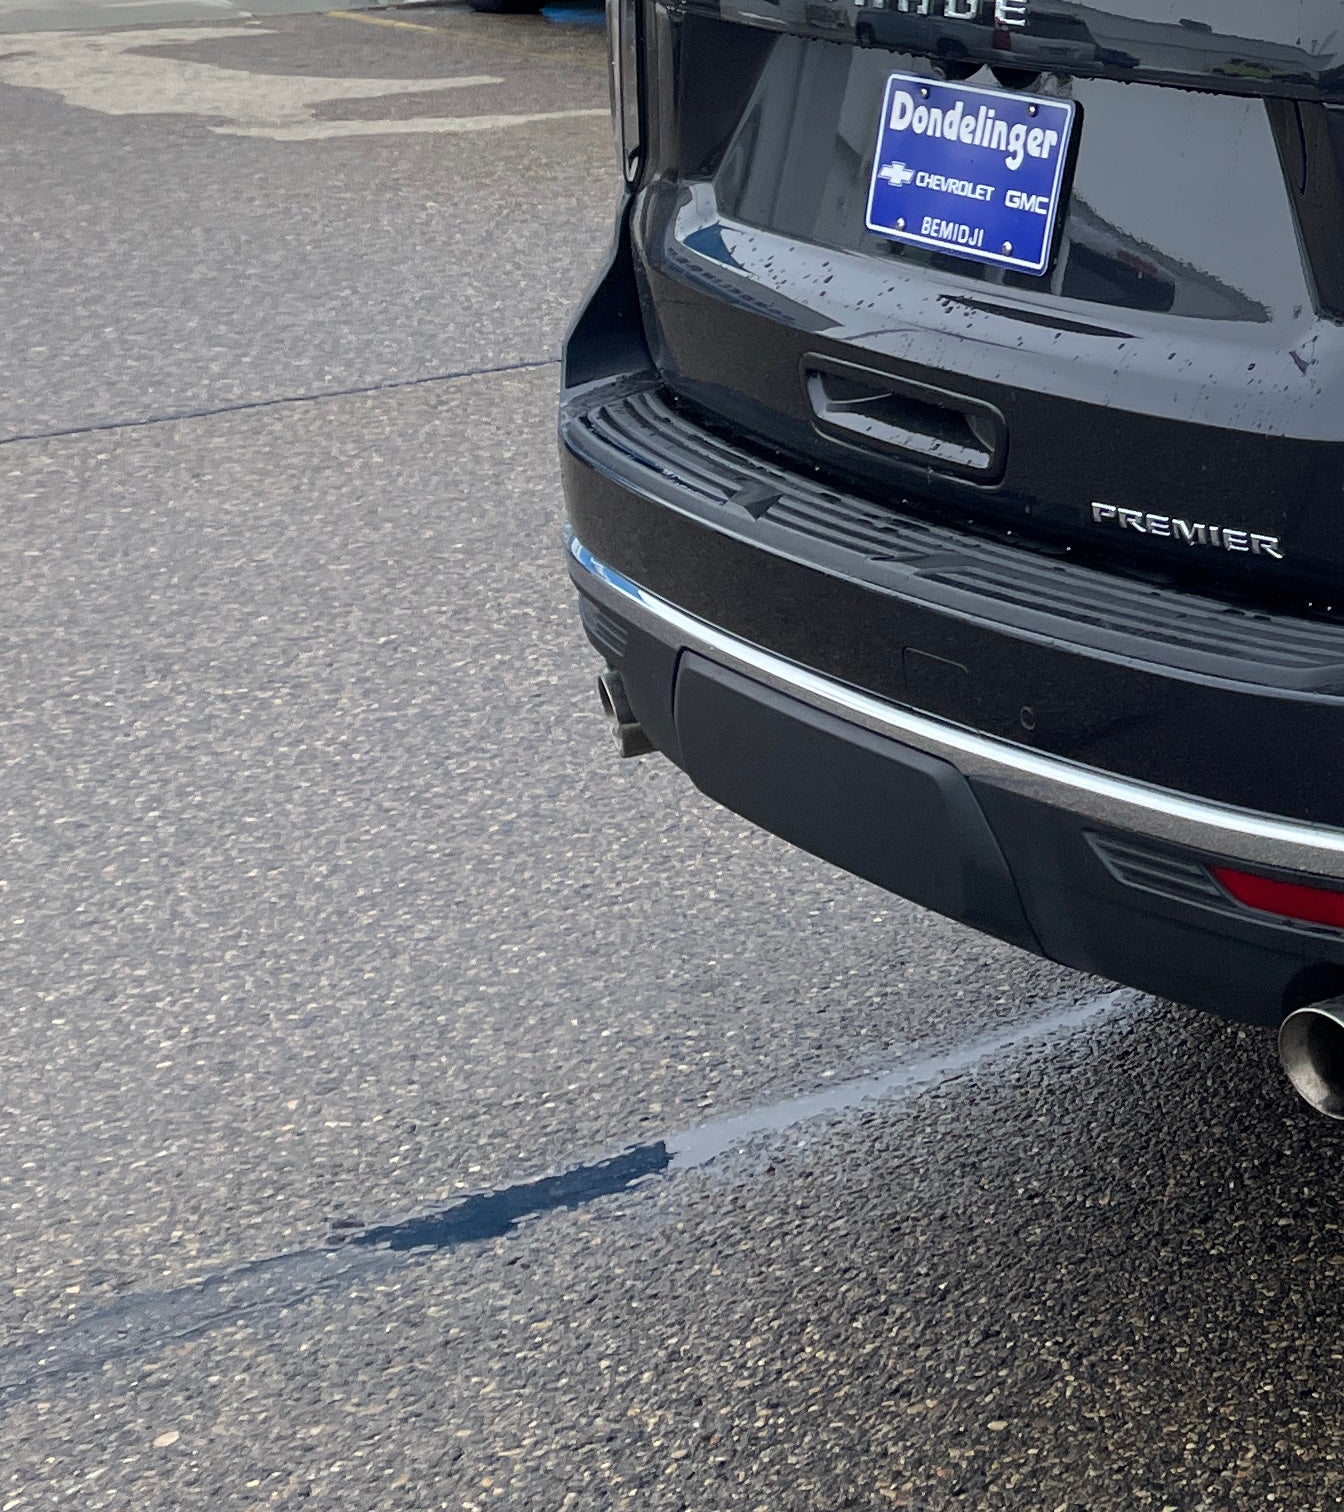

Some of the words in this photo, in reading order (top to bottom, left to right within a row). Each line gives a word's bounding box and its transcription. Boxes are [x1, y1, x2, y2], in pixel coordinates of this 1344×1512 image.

[889, 90, 1058, 171] Dondelinger
[915, 171, 996, 202] CHEVROLET
[1004, 189, 1050, 215] GMC
[921, 216, 985, 247] BEMIDJI
[1091, 501, 1285, 559] PREMIER
